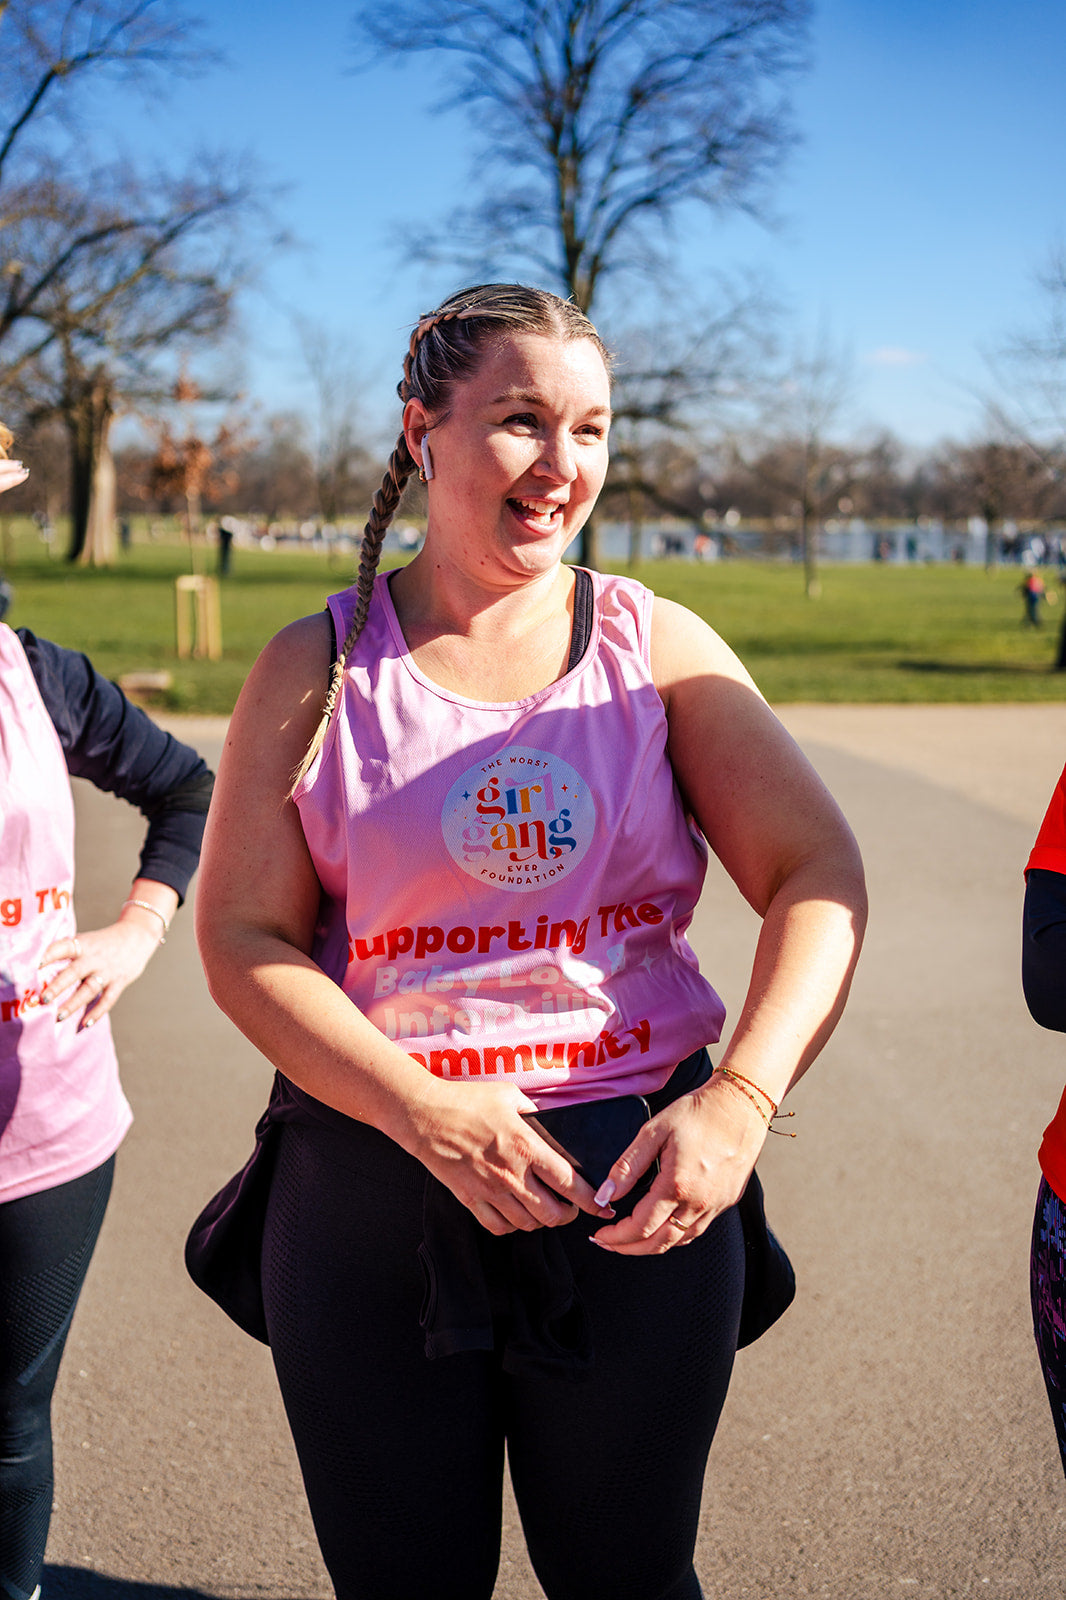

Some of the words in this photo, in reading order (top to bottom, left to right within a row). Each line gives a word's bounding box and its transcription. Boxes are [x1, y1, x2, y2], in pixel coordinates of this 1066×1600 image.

[480, 757, 503, 773] THE
[509, 756, 550, 770] WORST
[475, 772, 556, 825] girl
[461, 808, 578, 863] gang
[480, 863, 566, 885] FOUNDATION
[507, 864, 538, 873] EVER
[598, 902, 664, 939] The
[373, 959, 488, 1000] Baby
